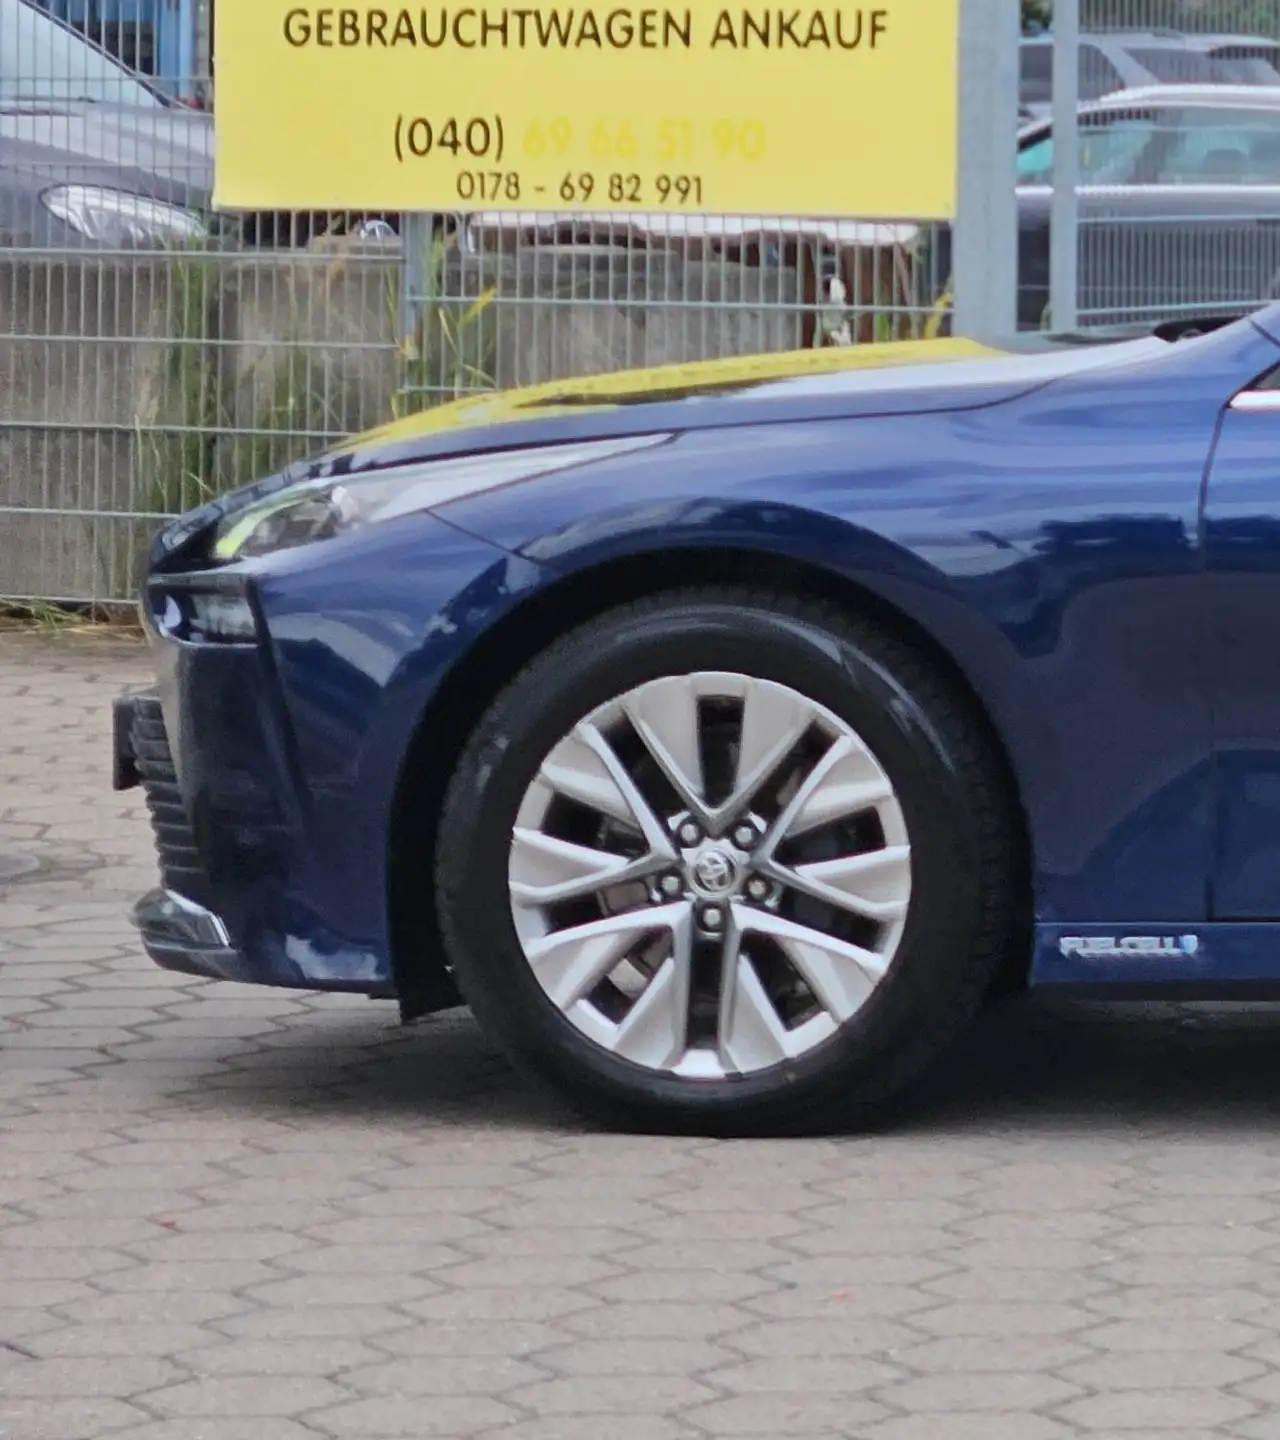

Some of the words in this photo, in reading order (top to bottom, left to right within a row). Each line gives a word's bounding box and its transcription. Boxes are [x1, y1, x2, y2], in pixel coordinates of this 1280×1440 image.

[282, 7, 692, 50] GEBRAUCHTWAGEN
[709, 8, 889, 50] ANKAUF
[393, 114, 505, 163] (040)
[456, 171, 521, 201] 0178
[558, 172, 595, 203] 69
[607, 173, 642, 203] 82
[654, 174, 703, 205] 991
